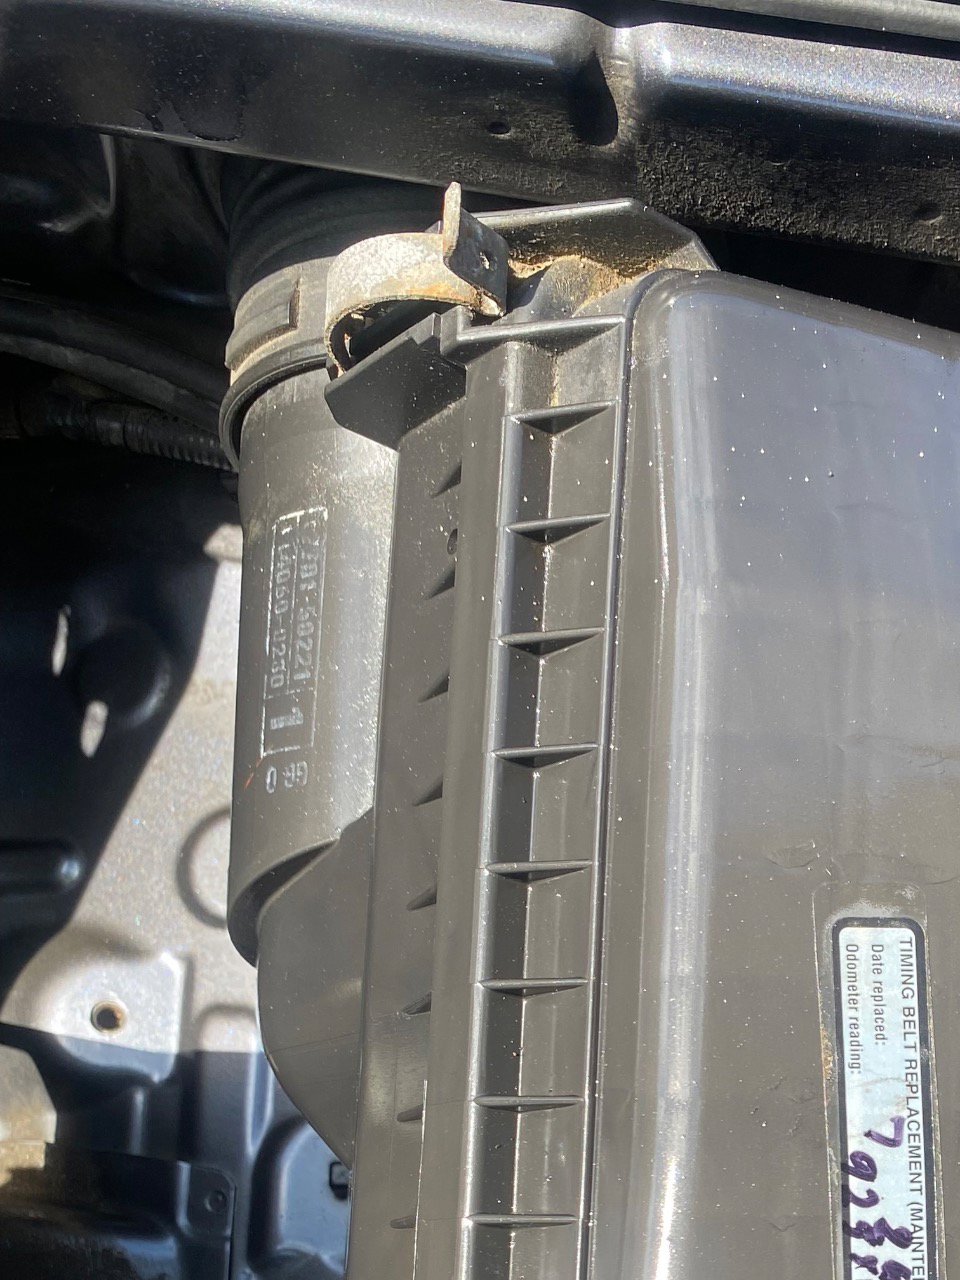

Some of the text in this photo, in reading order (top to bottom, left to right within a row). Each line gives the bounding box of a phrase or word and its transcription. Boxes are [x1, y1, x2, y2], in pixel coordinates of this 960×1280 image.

[845, 943, 863, 1075] Odometer reading:
[870, 943, 886, 1046] Date replaced:
[899, 937, 915, 1000] TIMING
[902, 1008, 917, 1053] BELT
[904, 1059, 923, 1197] REPLACEMENT
